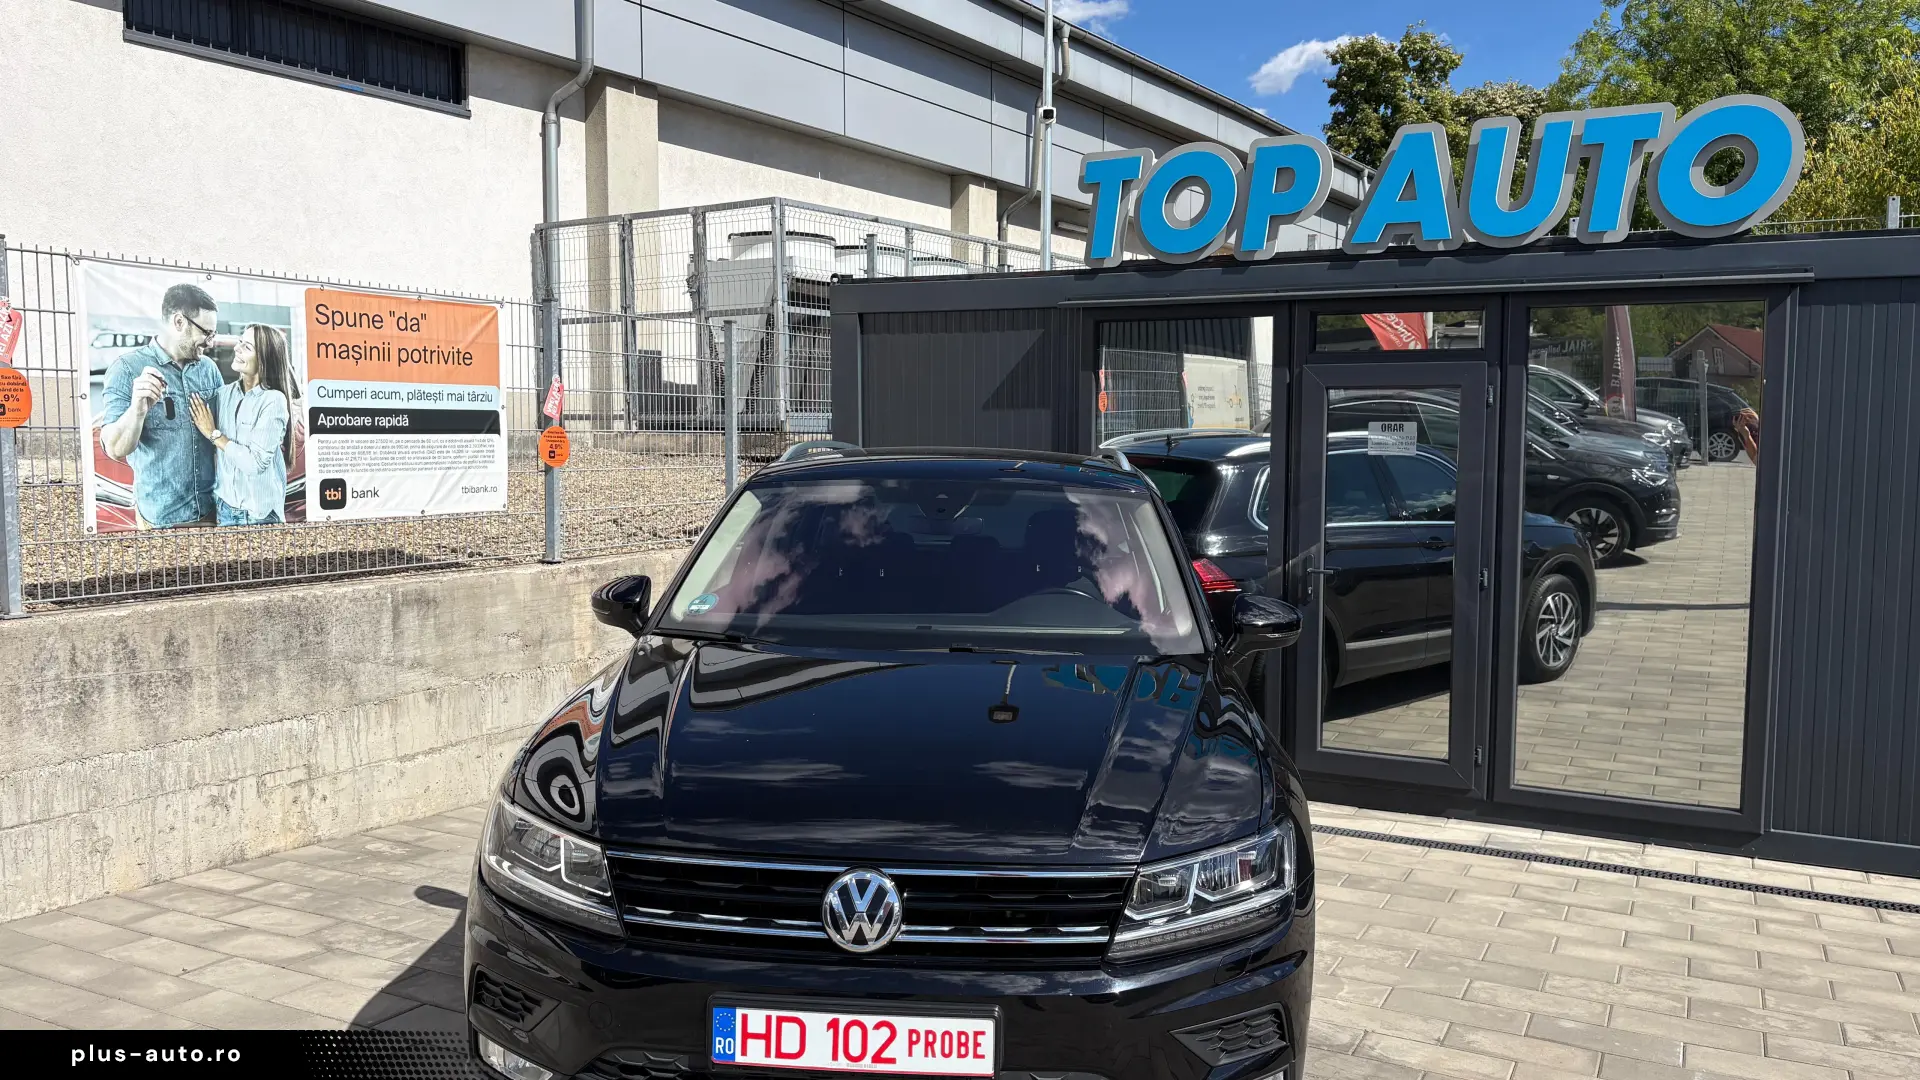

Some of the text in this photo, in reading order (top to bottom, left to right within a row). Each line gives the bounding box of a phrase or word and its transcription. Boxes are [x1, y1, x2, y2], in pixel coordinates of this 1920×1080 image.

[1083, 103, 1793, 260] TOP AUTO
[315, 303, 427, 333] Spune "da"
[316, 341, 473, 367] mașinii potrivite
[316, 386, 493, 404] Cumperi acum, plătești mai târziu
[317, 413, 409, 428] Aprobare rapidă
[1381, 423, 1404, 433] ORAR
[324, 484, 498, 500] tbi bank tbibank.ro
[715, 1013, 986, 1065] RO HD 102 PROBE
